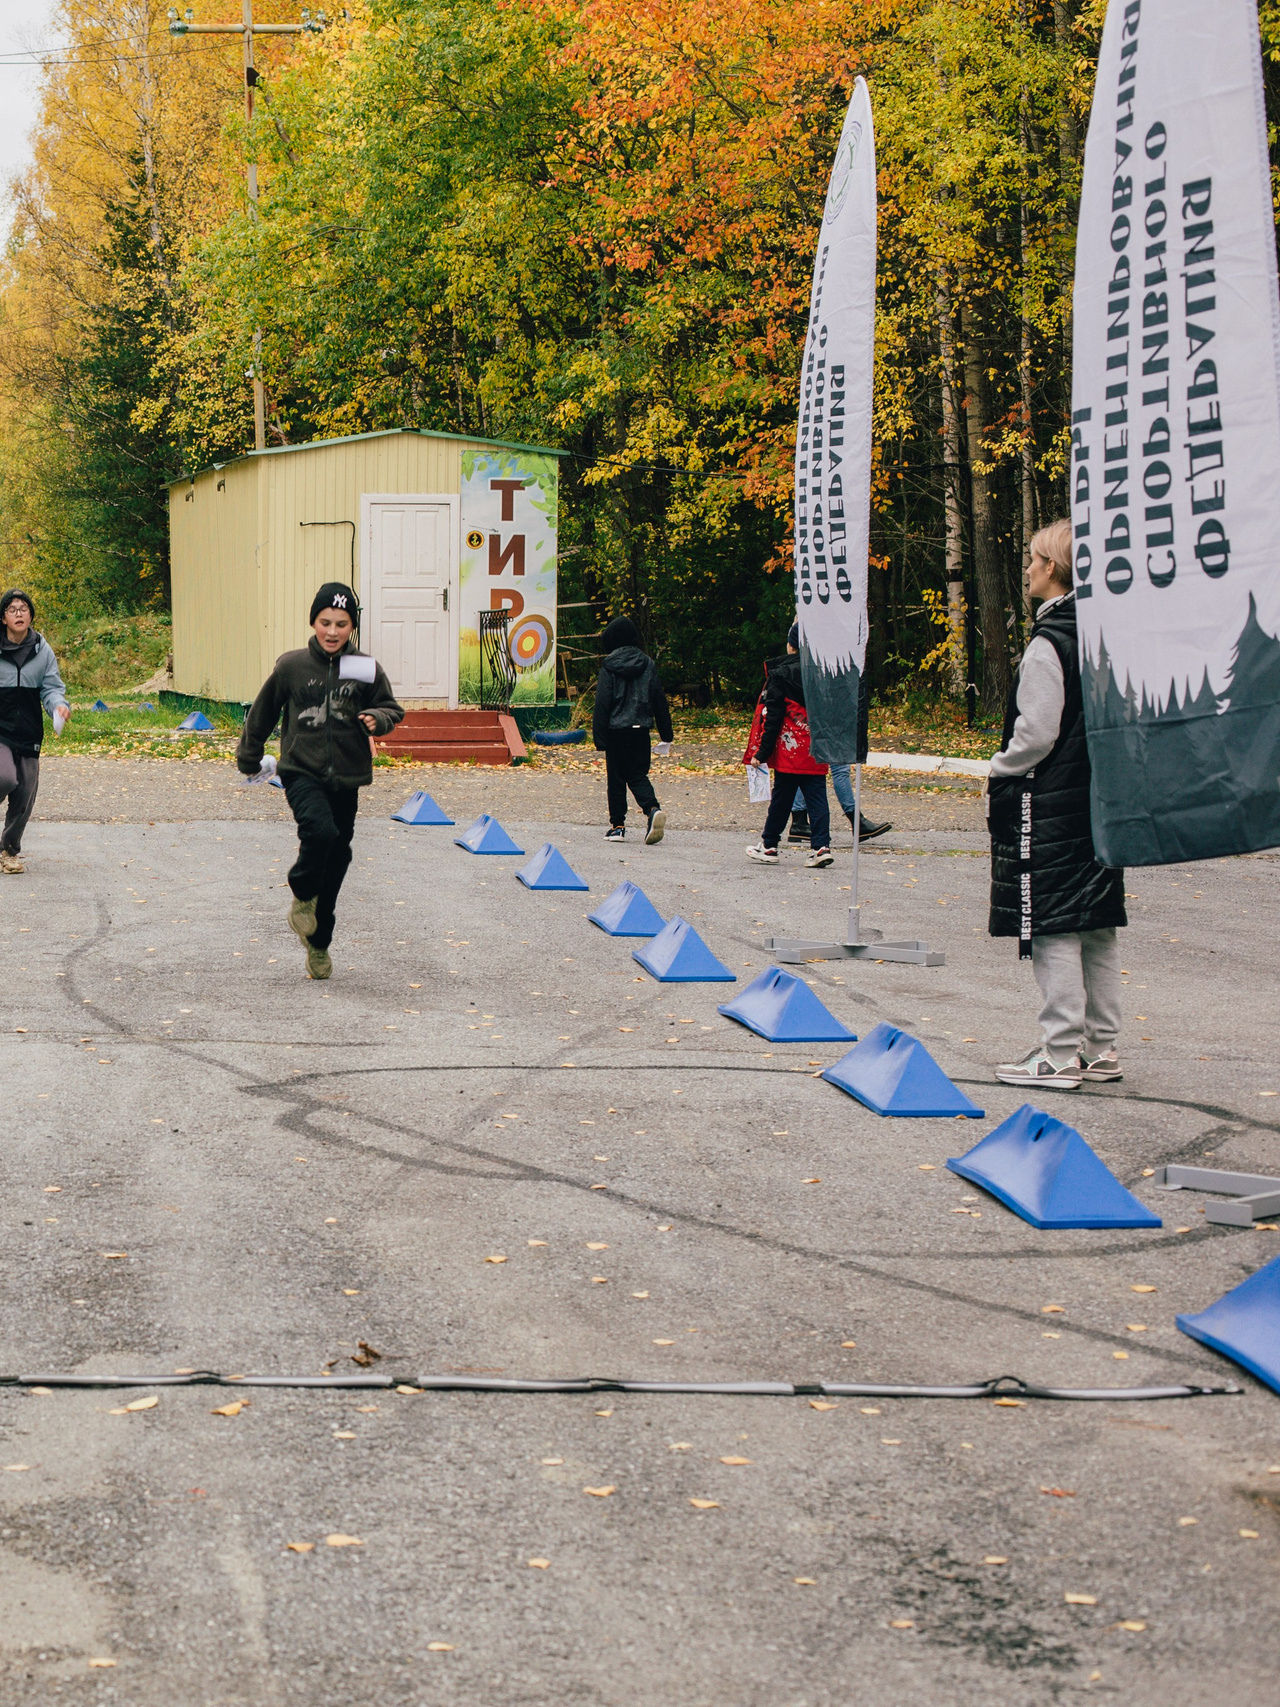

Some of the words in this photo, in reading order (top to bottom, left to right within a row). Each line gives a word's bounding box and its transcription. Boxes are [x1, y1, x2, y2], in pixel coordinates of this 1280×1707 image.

[488, 479, 526, 630] ТИР
[1021, 792, 1032, 834] CLASSIC
[1020, 834, 1031, 860] BEST
[1021, 873, 1032, 915] CLASSIC
[1021, 915, 1032, 940] BEST
